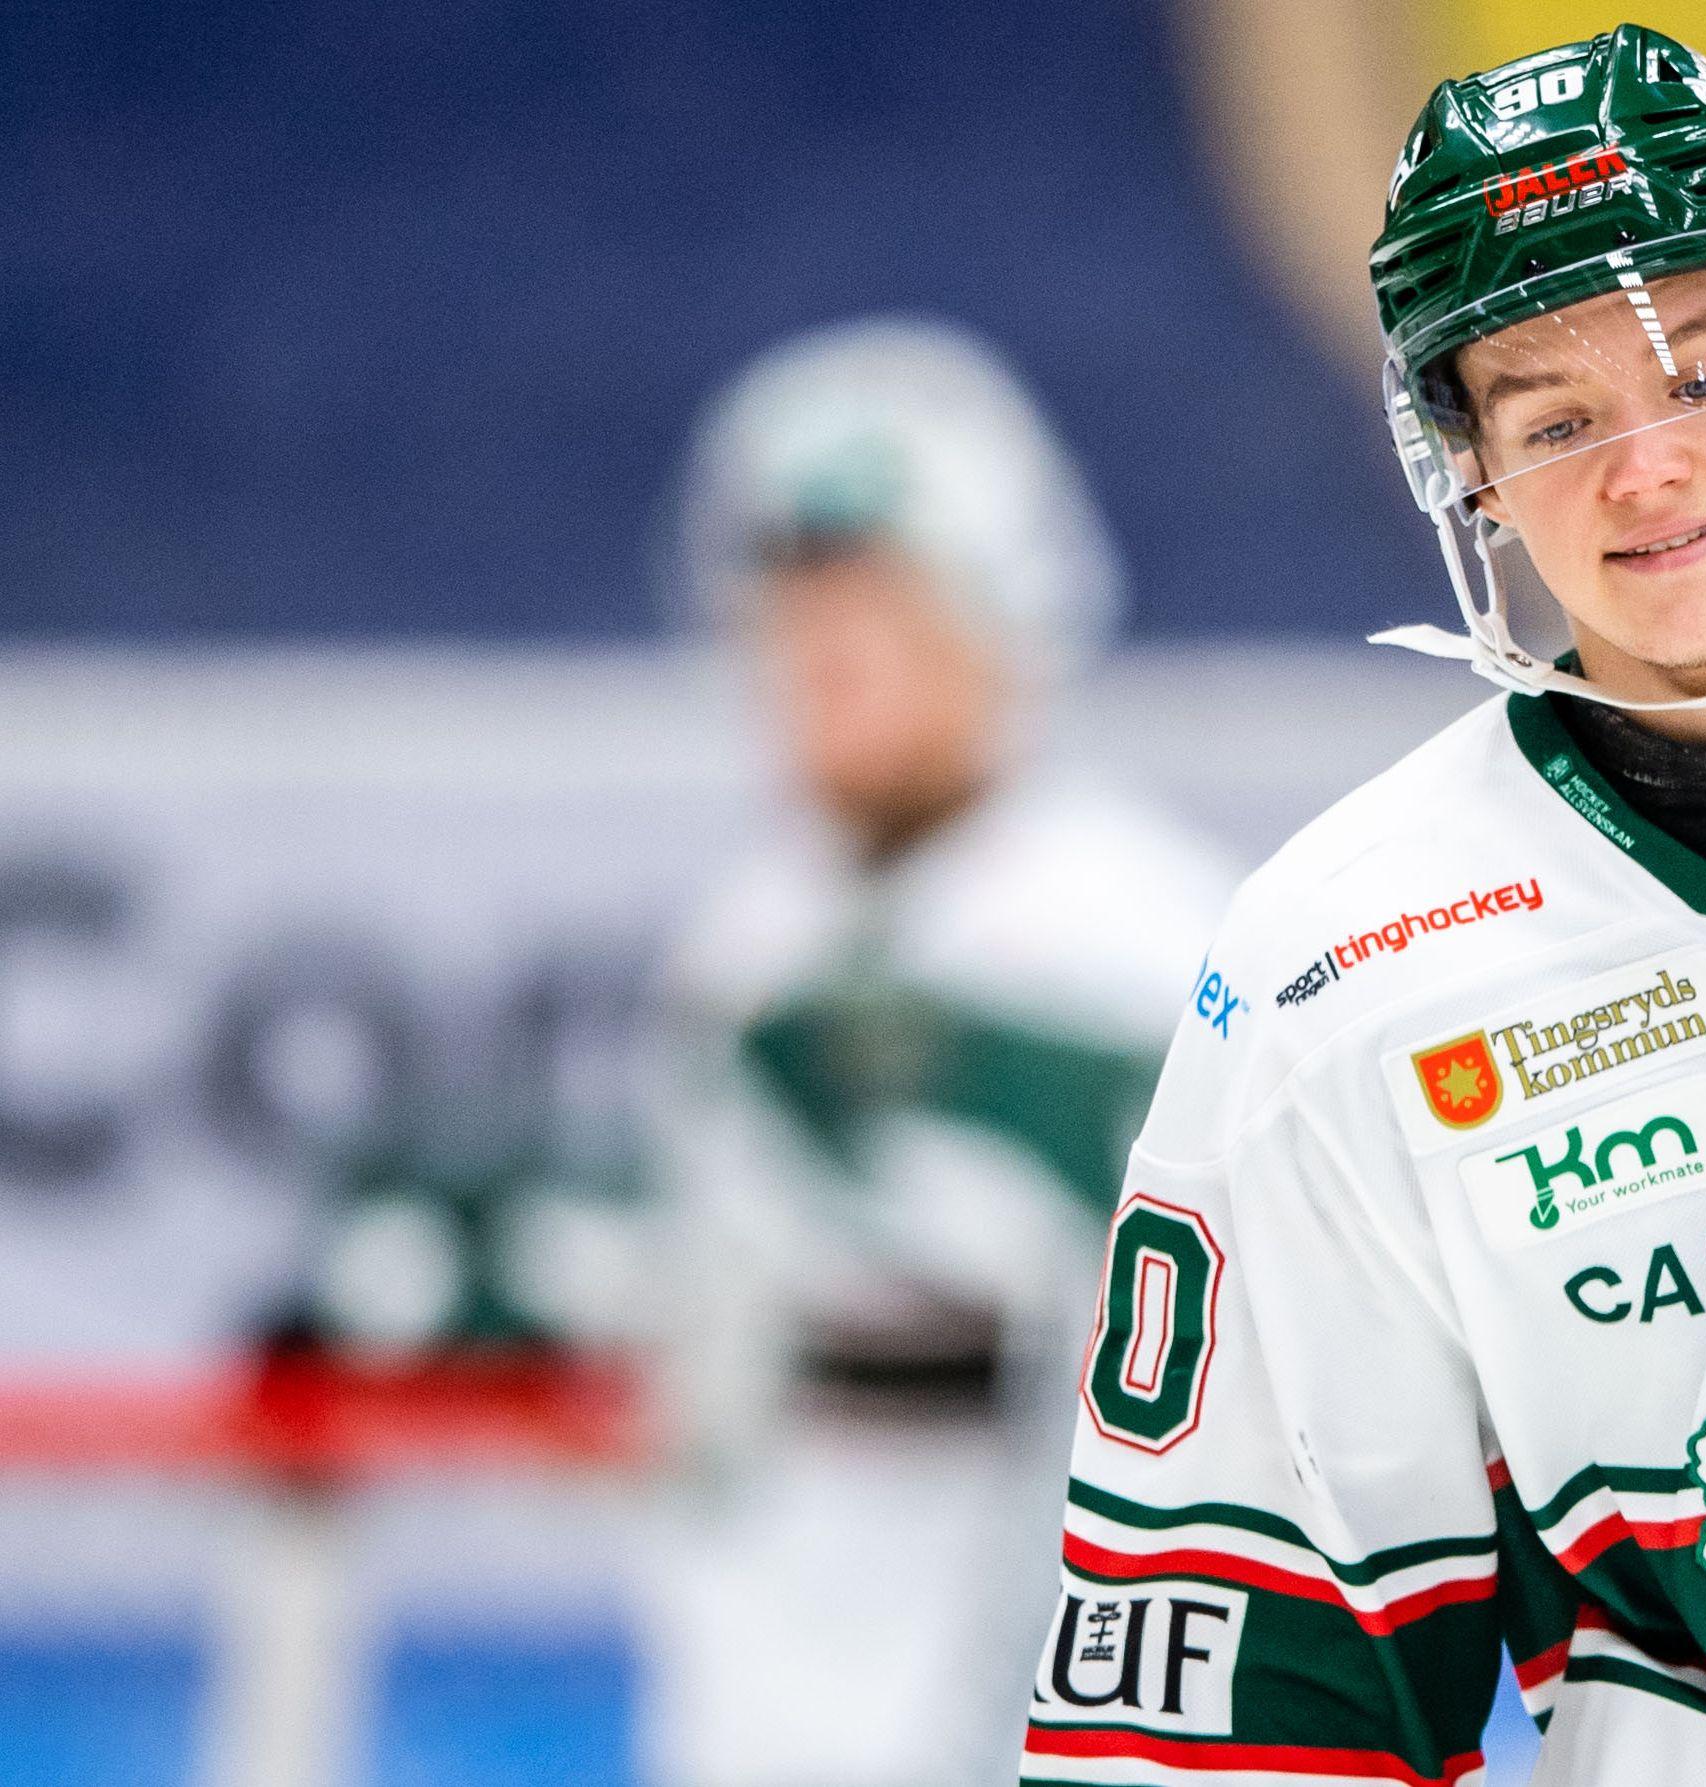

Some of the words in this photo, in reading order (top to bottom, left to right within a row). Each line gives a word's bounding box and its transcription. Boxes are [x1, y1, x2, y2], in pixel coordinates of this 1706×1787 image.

[1495, 65, 1584, 121] 90
[1275, 960, 1327, 1009] sport
[1490, 970, 1697, 1067] Tingsryds
[1565, 1190, 1606, 1215] Your
[1612, 1161, 1705, 1198] workmate
[1034, 1593, 1230, 1716] UF
